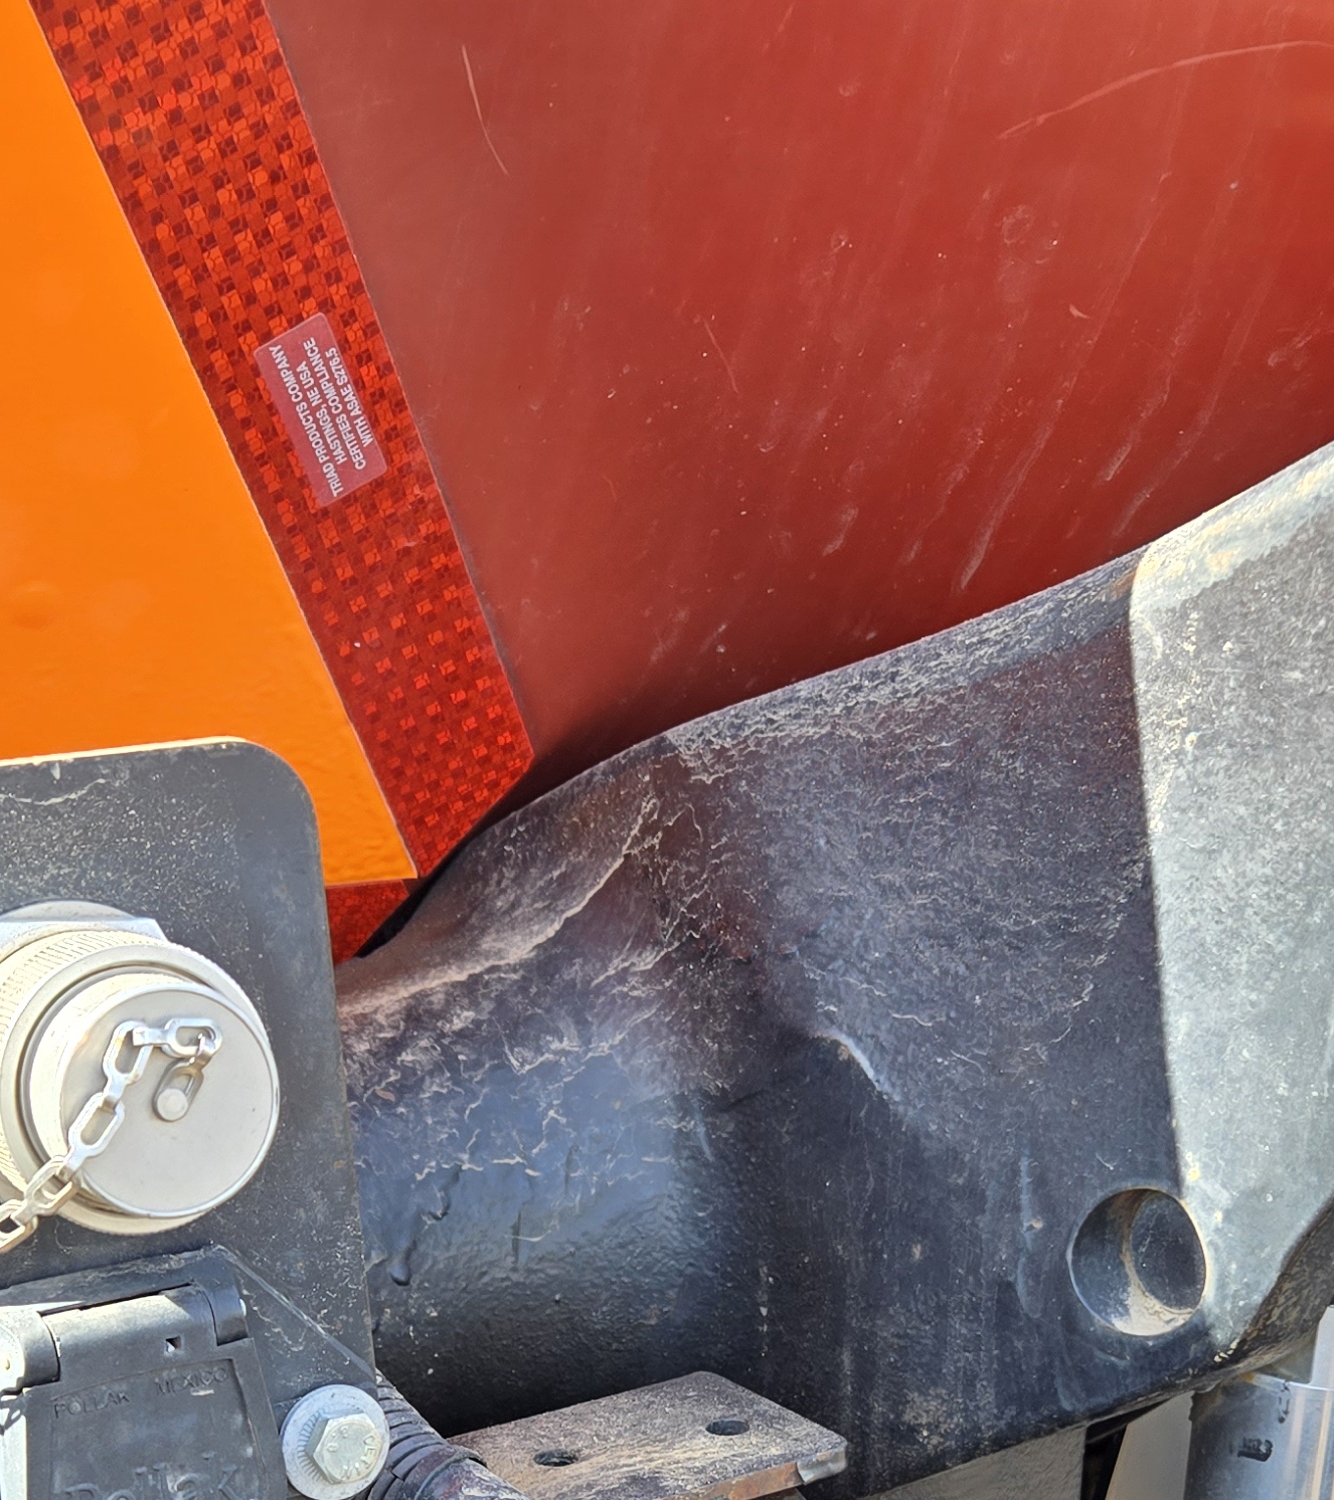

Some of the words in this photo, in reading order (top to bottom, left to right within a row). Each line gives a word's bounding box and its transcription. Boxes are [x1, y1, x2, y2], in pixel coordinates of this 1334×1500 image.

[269, 344, 303, 402] COMPANY
[296, 360, 315, 389] USA
[303, 336, 343, 414] COMPLIANCE
[325, 347, 349, 386] S276.5
[306, 387, 323, 407] NE
[340, 384, 362, 418] ASAE
[296, 401, 330, 463] PRODUCTS
[316, 405, 348, 465] HASTINGS,
[335, 413, 366, 470] CERTIFIES
[353, 420, 374, 447] WITH
[322, 462, 344, 497] TRIAD
[53, 1391, 131, 1419] POLLAK
[153, 1367, 229, 1396] MEXICO
